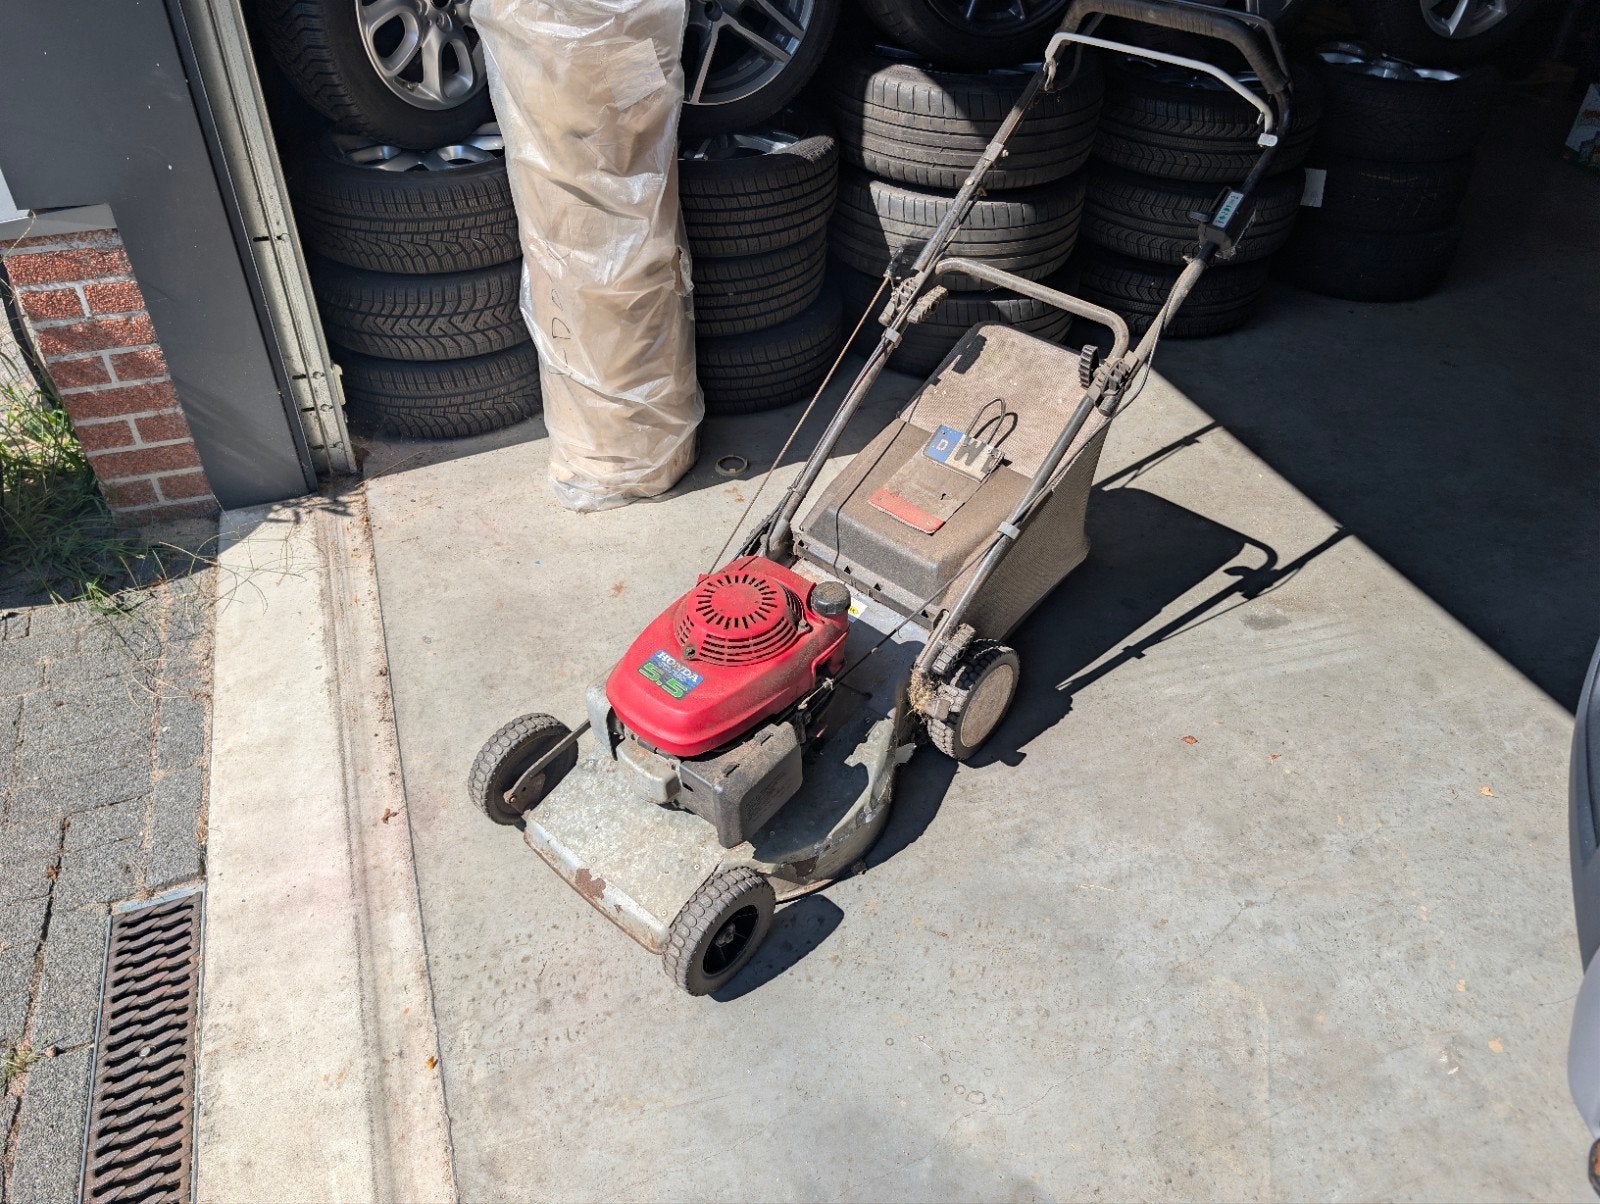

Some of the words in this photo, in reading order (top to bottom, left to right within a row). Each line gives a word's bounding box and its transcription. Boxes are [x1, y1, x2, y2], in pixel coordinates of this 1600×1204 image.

[935, 438, 949, 451] D
[638, 662, 688, 698] 5.5
[657, 651, 699, 683] HONDA
